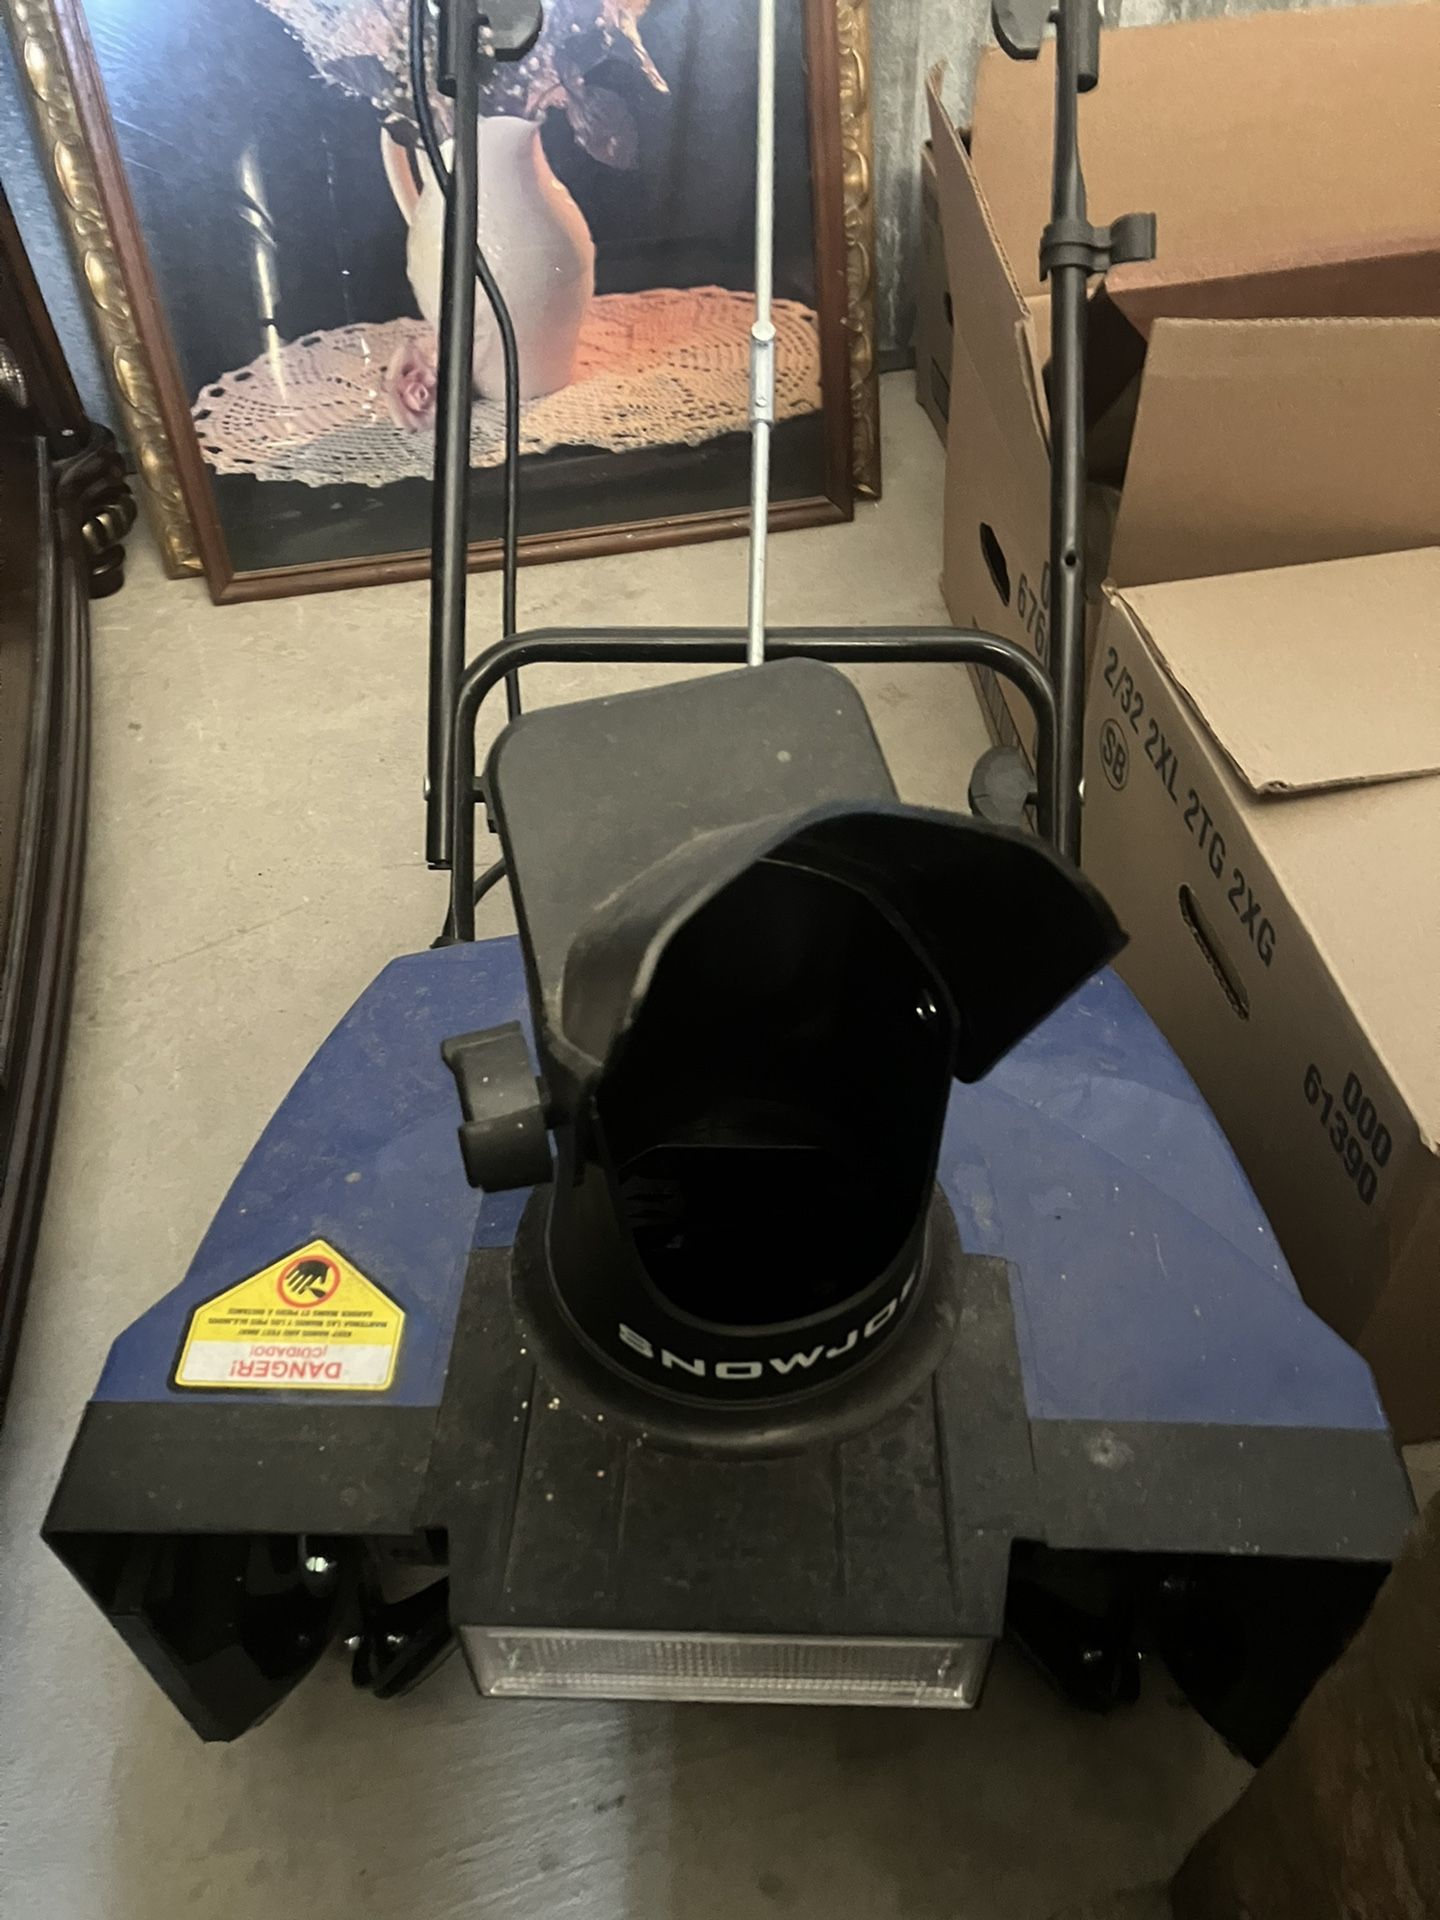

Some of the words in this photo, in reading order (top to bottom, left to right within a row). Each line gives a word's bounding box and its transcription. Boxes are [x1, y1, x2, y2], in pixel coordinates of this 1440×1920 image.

[1018, 573, 1050, 672] 676
[1103, 726, 1127, 785] SB
[1103, 646, 1144, 734] 2/32
[1144, 717, 1179, 803] 2XL
[1183, 788, 1227, 879] 2TG
[1227, 867, 1277, 968] 2XG
[1303, 1063, 1378, 1206] 61390
[1342, 1071, 1393, 1169] 000
[229, 1360, 342, 1379] DANGER!
